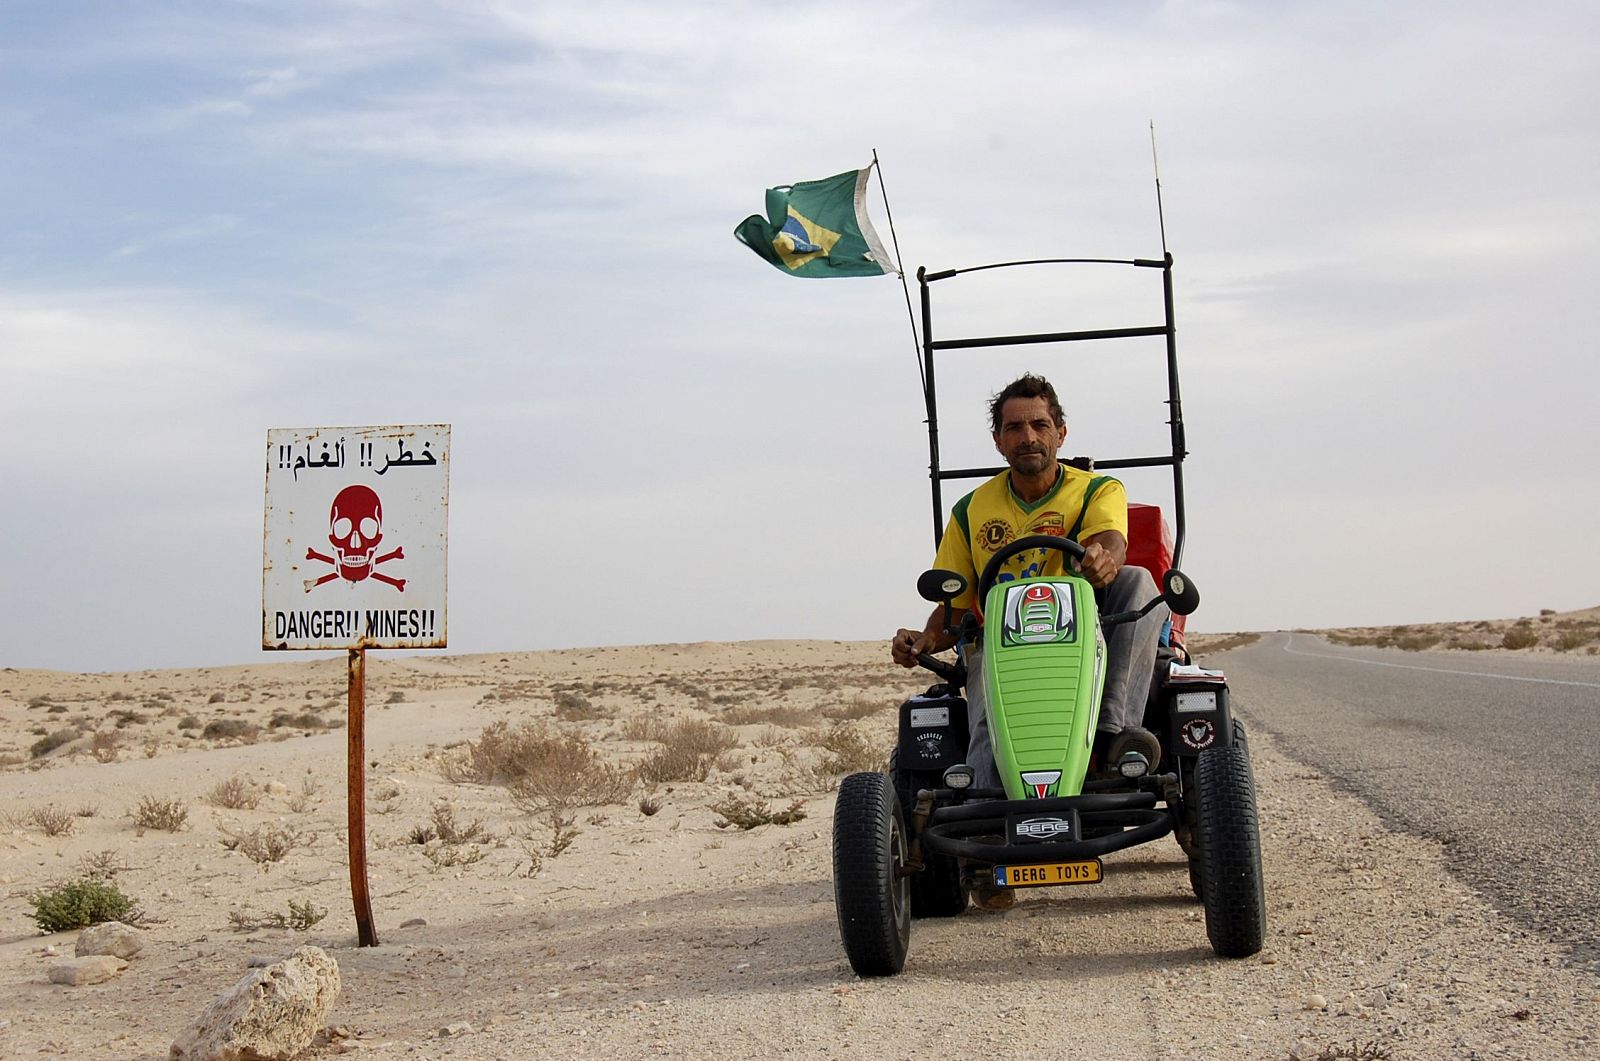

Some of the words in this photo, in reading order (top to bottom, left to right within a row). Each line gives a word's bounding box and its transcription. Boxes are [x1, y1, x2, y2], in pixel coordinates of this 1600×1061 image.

[360, 438, 437, 475] خطر!!
[991, 527, 999, 541] L
[1034, 588, 1042, 597] 1
[275, 610, 359, 639] DANGER!!
[365, 609, 435, 639] MINES!!
[1016, 820, 1069, 836] BERG
[1012, 868, 1046, 882] BERG
[1056, 866, 1089, 879] TOYS
